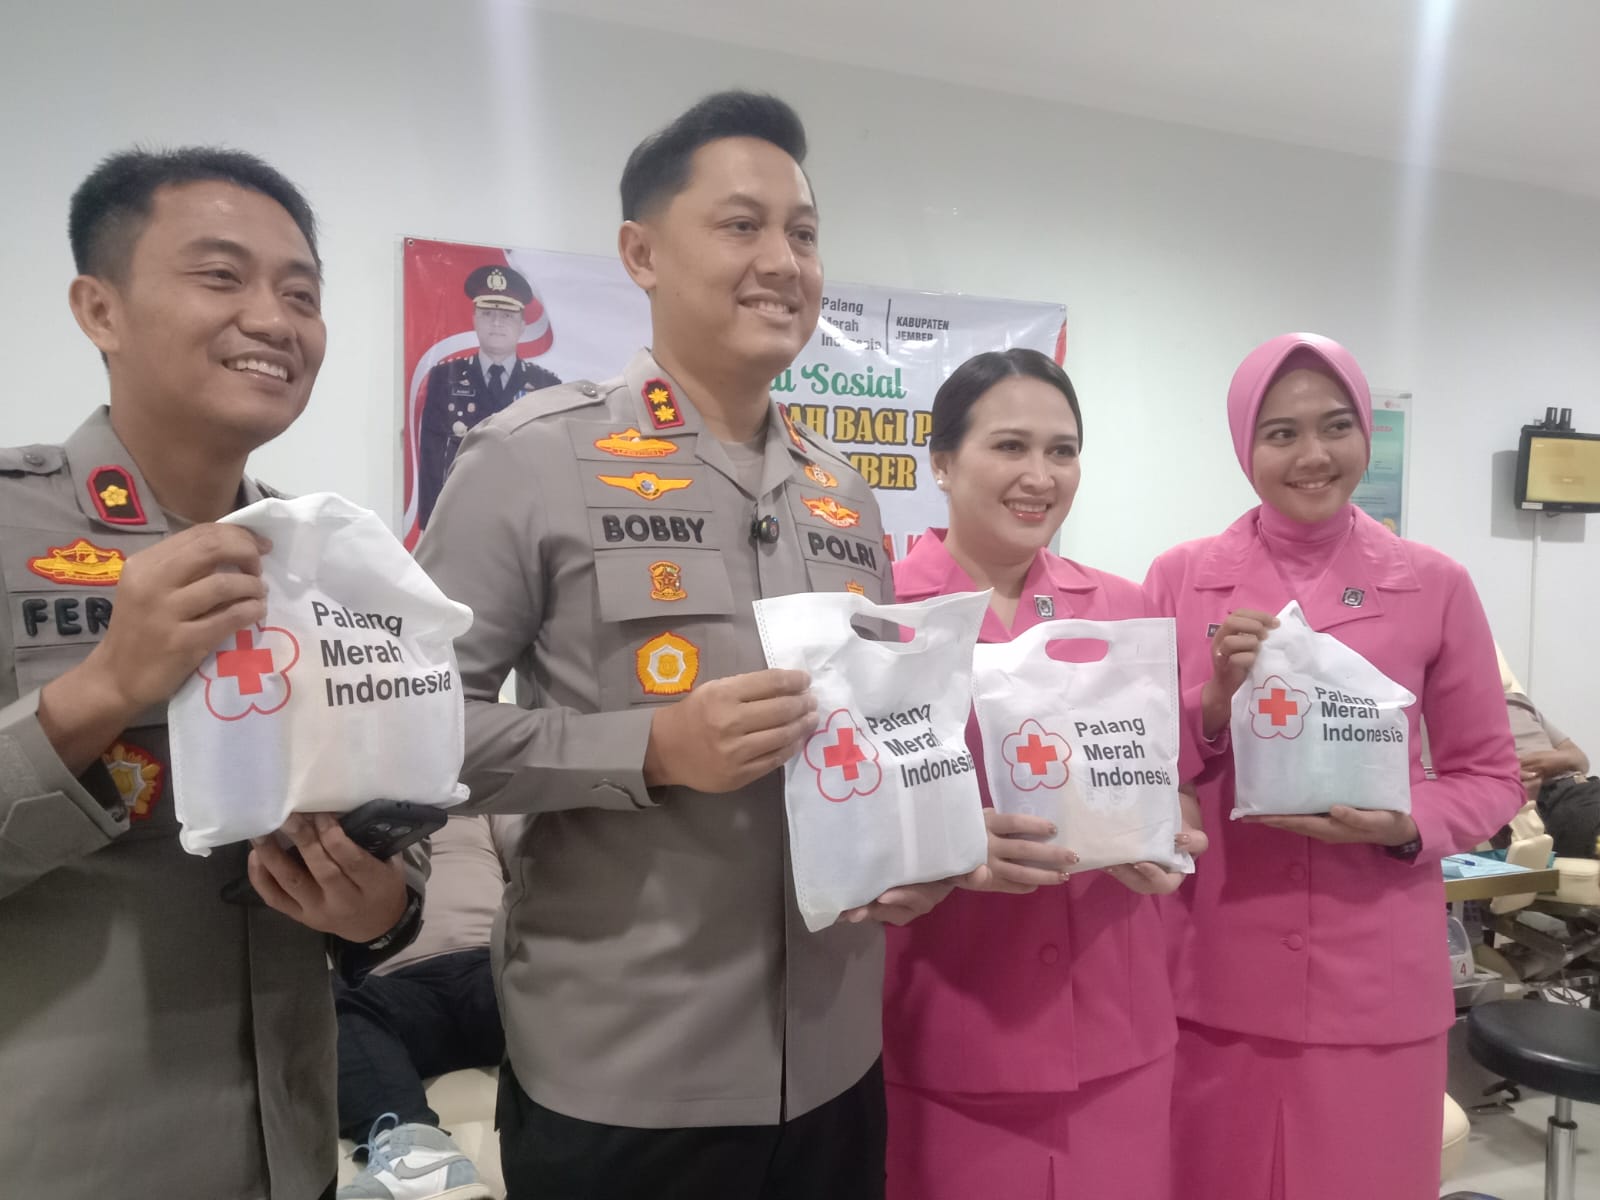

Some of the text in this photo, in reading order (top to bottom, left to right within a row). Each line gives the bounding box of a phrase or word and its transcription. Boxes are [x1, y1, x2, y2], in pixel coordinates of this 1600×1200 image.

[822, 297, 864, 316] Palang
[822, 315, 859, 332] erah
[896, 316, 949, 330] KABUPATEN
[801, 363, 907, 399] Sosial
[832, 405, 908, 445] BAGI
[602, 514, 704, 543] BOBBY
[808, 532, 877, 571] POLRI
[312, 601, 402, 637] Palang
[320, 640, 404, 667] Merah
[325, 671, 451, 706] Indonesia
[864, 703, 932, 735] Palang
[1074, 718, 1146, 736] Palang
[1323, 723, 1403, 742] Indonesia
[1083, 740, 1145, 761] Merah
[1090, 766, 1171, 788] Indonesia
